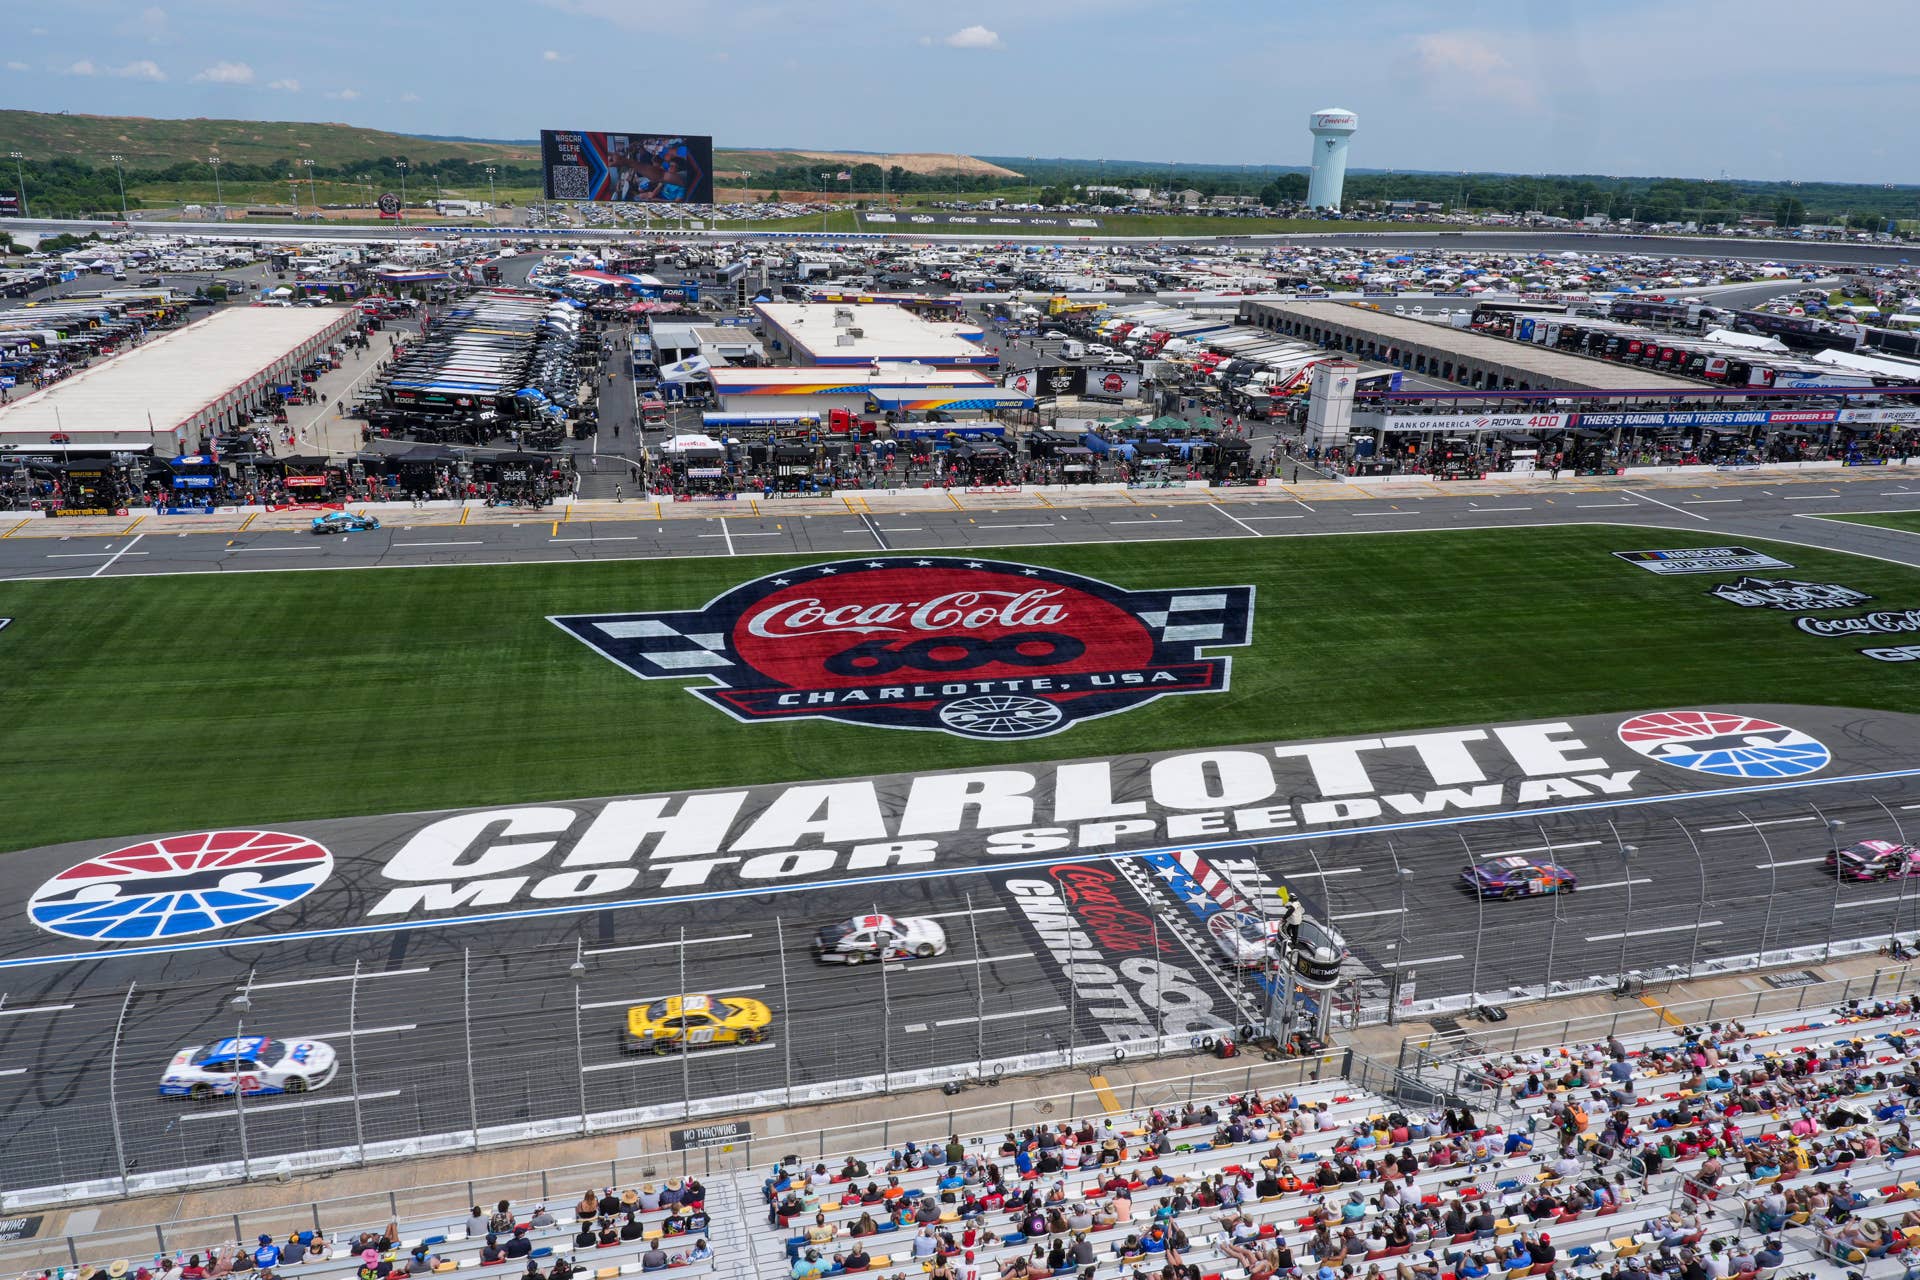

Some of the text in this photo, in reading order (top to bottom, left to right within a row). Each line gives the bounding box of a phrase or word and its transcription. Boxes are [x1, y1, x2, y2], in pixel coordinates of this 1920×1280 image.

[555, 135, 582, 143] NASCAR
[558, 144, 581, 153] SELFIE
[562, 153, 578, 162] CAM
[663, 289, 684, 297] FORD
[17, 344, 30, 354] 18
[1491, 416, 1560, 427] ROVAL 400
[1583, 412, 1766, 425] THERE'S RACING, THEN THERE'S ROVAL
[1770, 412, 1836, 421] OCTOBER 13
[1394, 421, 1418, 429] BANK
[1432, 420, 1470, 428] AMERICA
[56, 509, 93, 517] OPERATION
[1665, 548, 1739, 559] NASCAR
[1659, 557, 1762, 570] CUP SERIES
[1712, 583, 1872, 608] BUSCH
[1776, 599, 1861, 611] LIGHT
[748, 587, 1070, 639] Coca-Cola
[1797, 610, 1920, 637] Coca-Col
[823, 631, 1087, 677] 600
[777, 670, 1178, 706] CHARLOTTE, USA
[381, 721, 1611, 882] CHARLOTTE
[366, 769, 1643, 917] MOTOR SPEEDWAY
[1049, 864, 1177, 954] Coca-Cola
[1005, 879, 1159, 1043] CHARLOTTE
[689, 1028, 715, 1044] 00
[683, 1123, 737, 1141] NO THROWING
